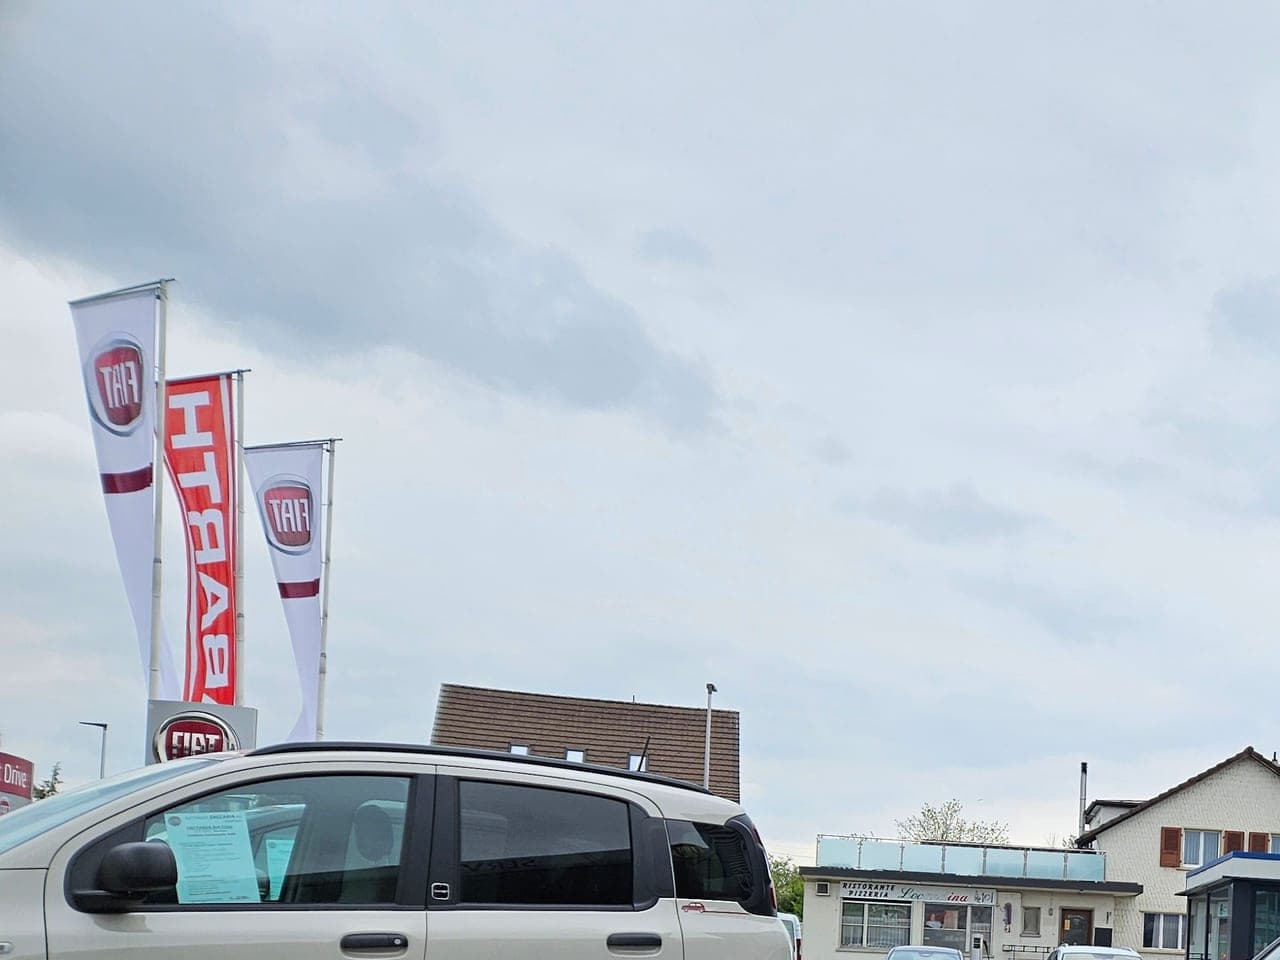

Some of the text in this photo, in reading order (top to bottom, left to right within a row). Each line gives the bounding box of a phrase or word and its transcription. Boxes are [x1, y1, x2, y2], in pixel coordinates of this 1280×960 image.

[172, 731, 220, 759] FIAT
[4, 763, 27, 788] Drive
[842, 882, 896, 892] RISTORANTE
[848, 890, 889, 898] PIZZERIA
